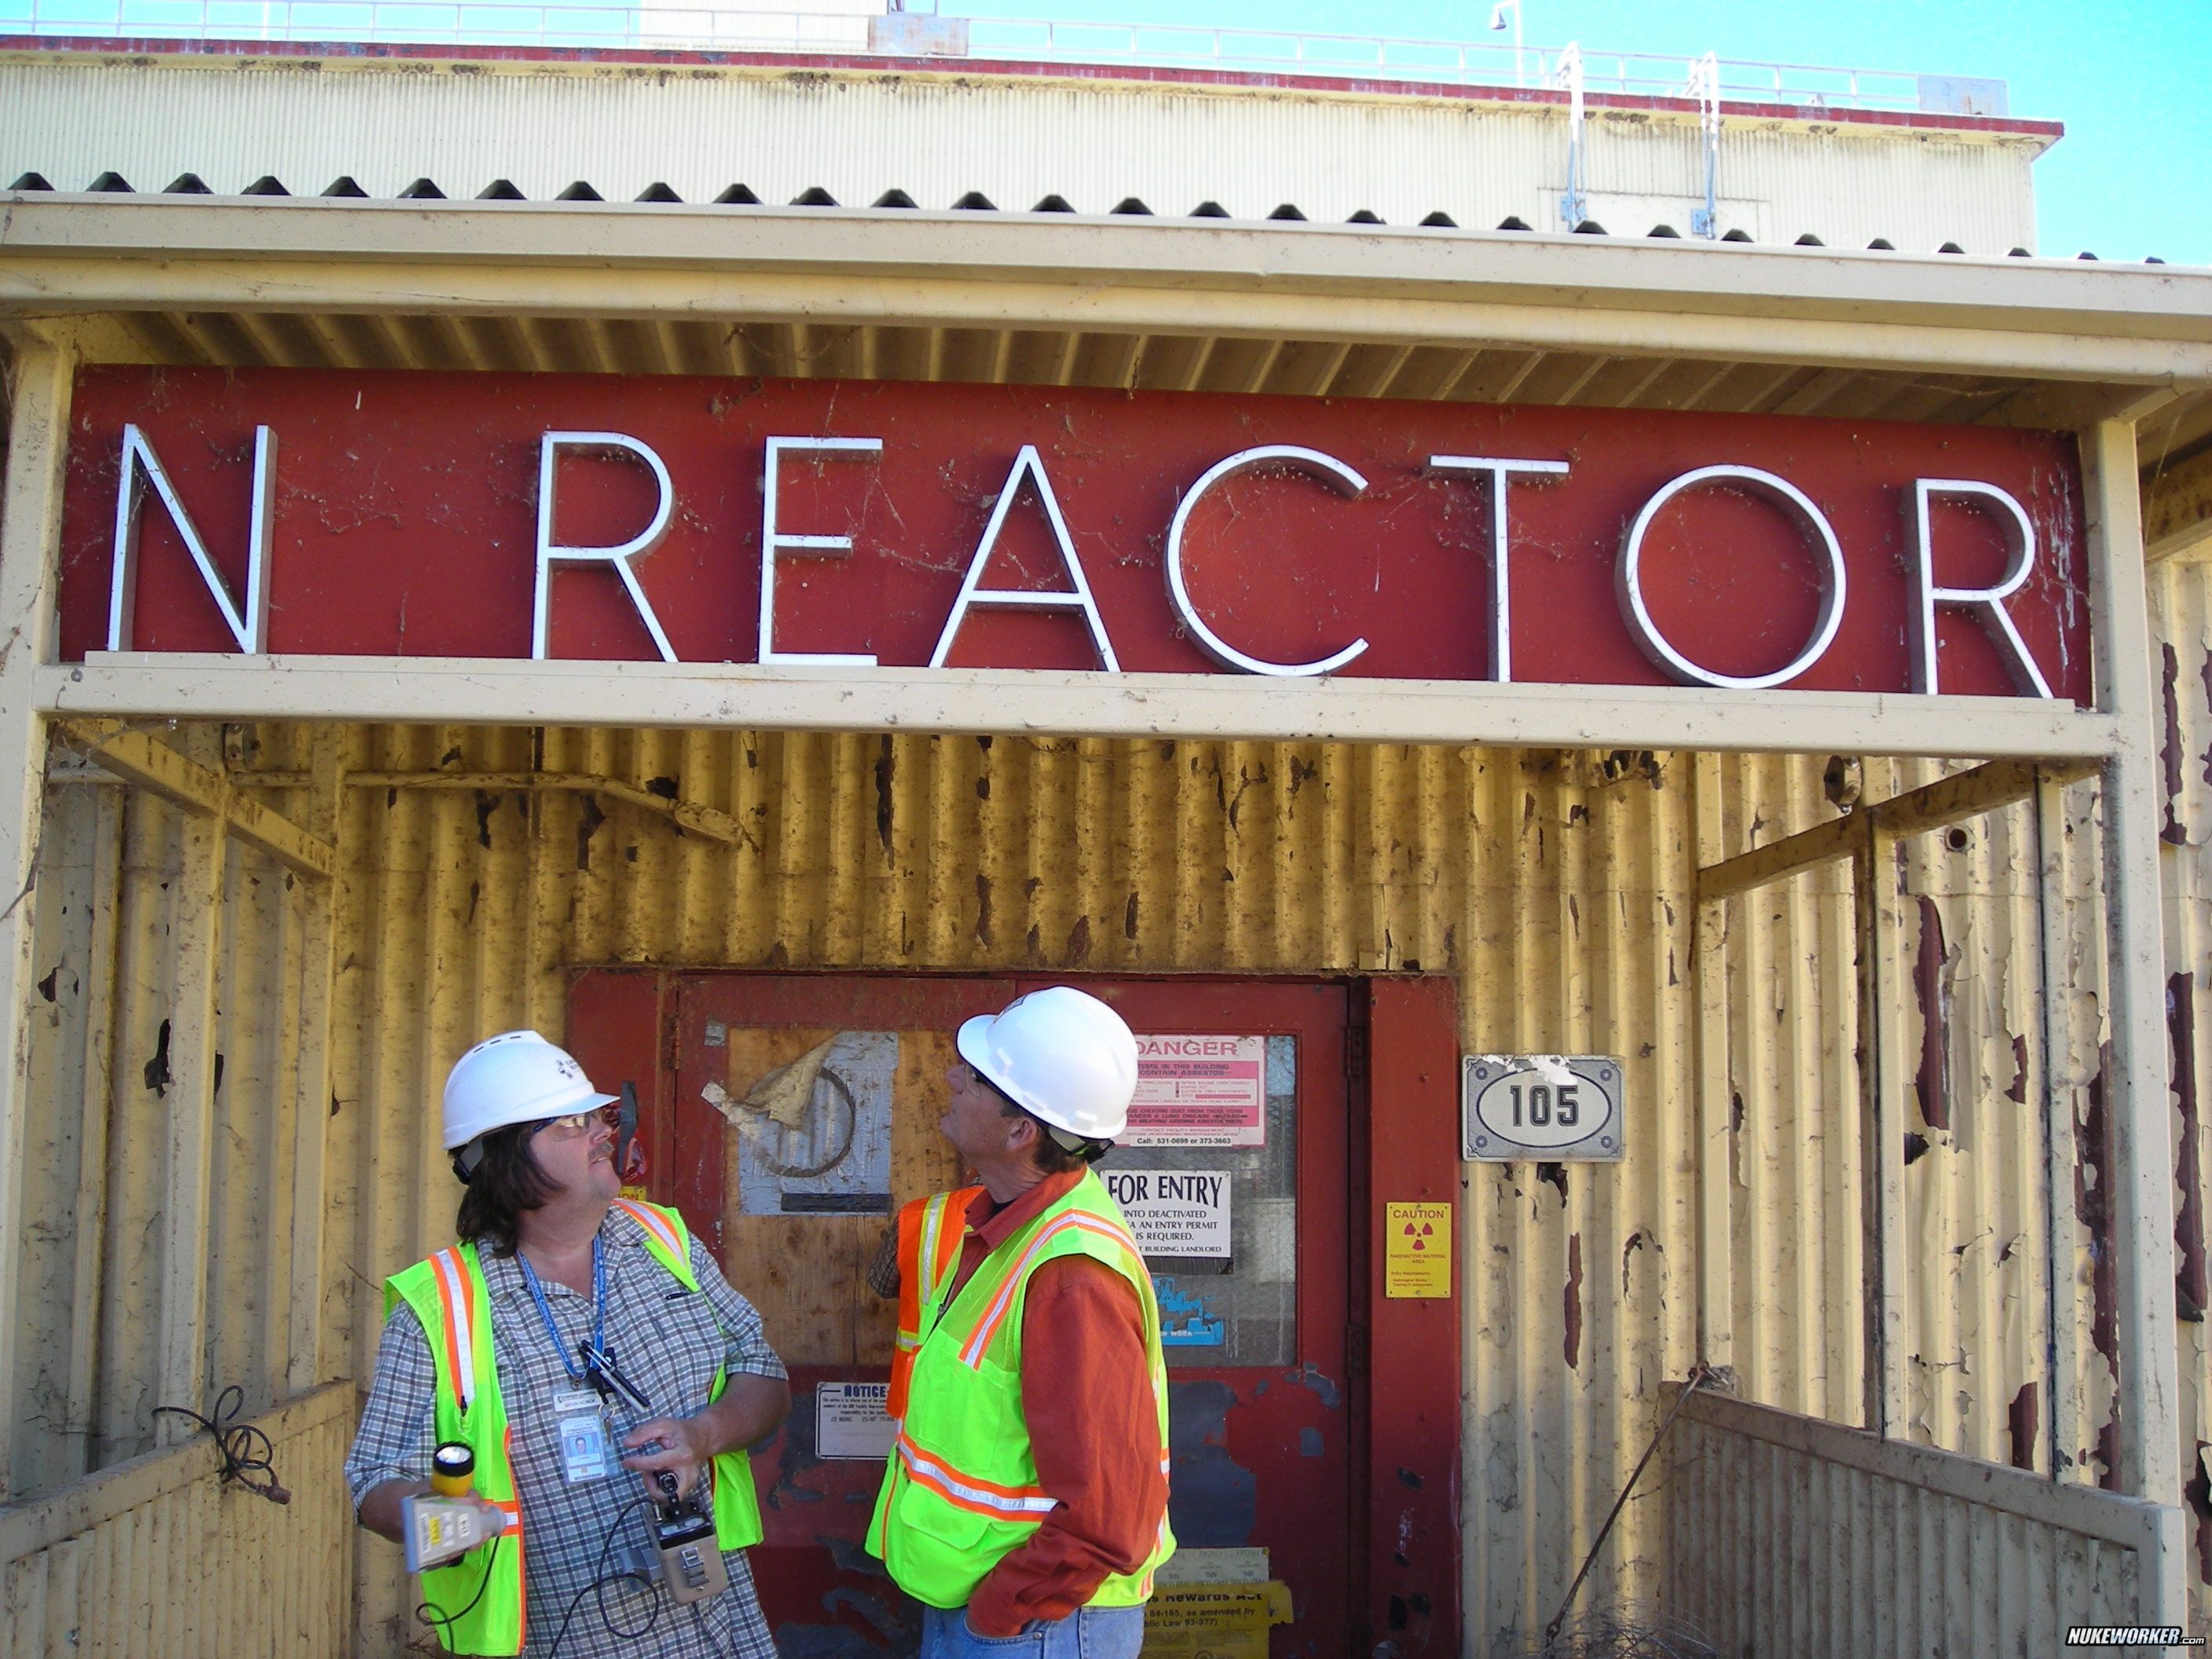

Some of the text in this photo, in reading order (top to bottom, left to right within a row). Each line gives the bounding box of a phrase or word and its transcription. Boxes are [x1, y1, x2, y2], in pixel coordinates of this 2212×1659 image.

[108, 423, 2054, 700] N REACTOR
[1511, 1085, 1579, 1126] 105
[1108, 1174, 1222, 1209] FOR ENTRY
[1393, 1210, 1445, 1218] CAUTION
[1147, 1232, 1194, 1241] REQUIRED.
[551, 1329, 569, 1362] Hanford
[844, 1384, 886, 1397] NOTICE
[1199, 1608, 1241, 1617] amended
[1244, 1607, 1255, 1616] by
